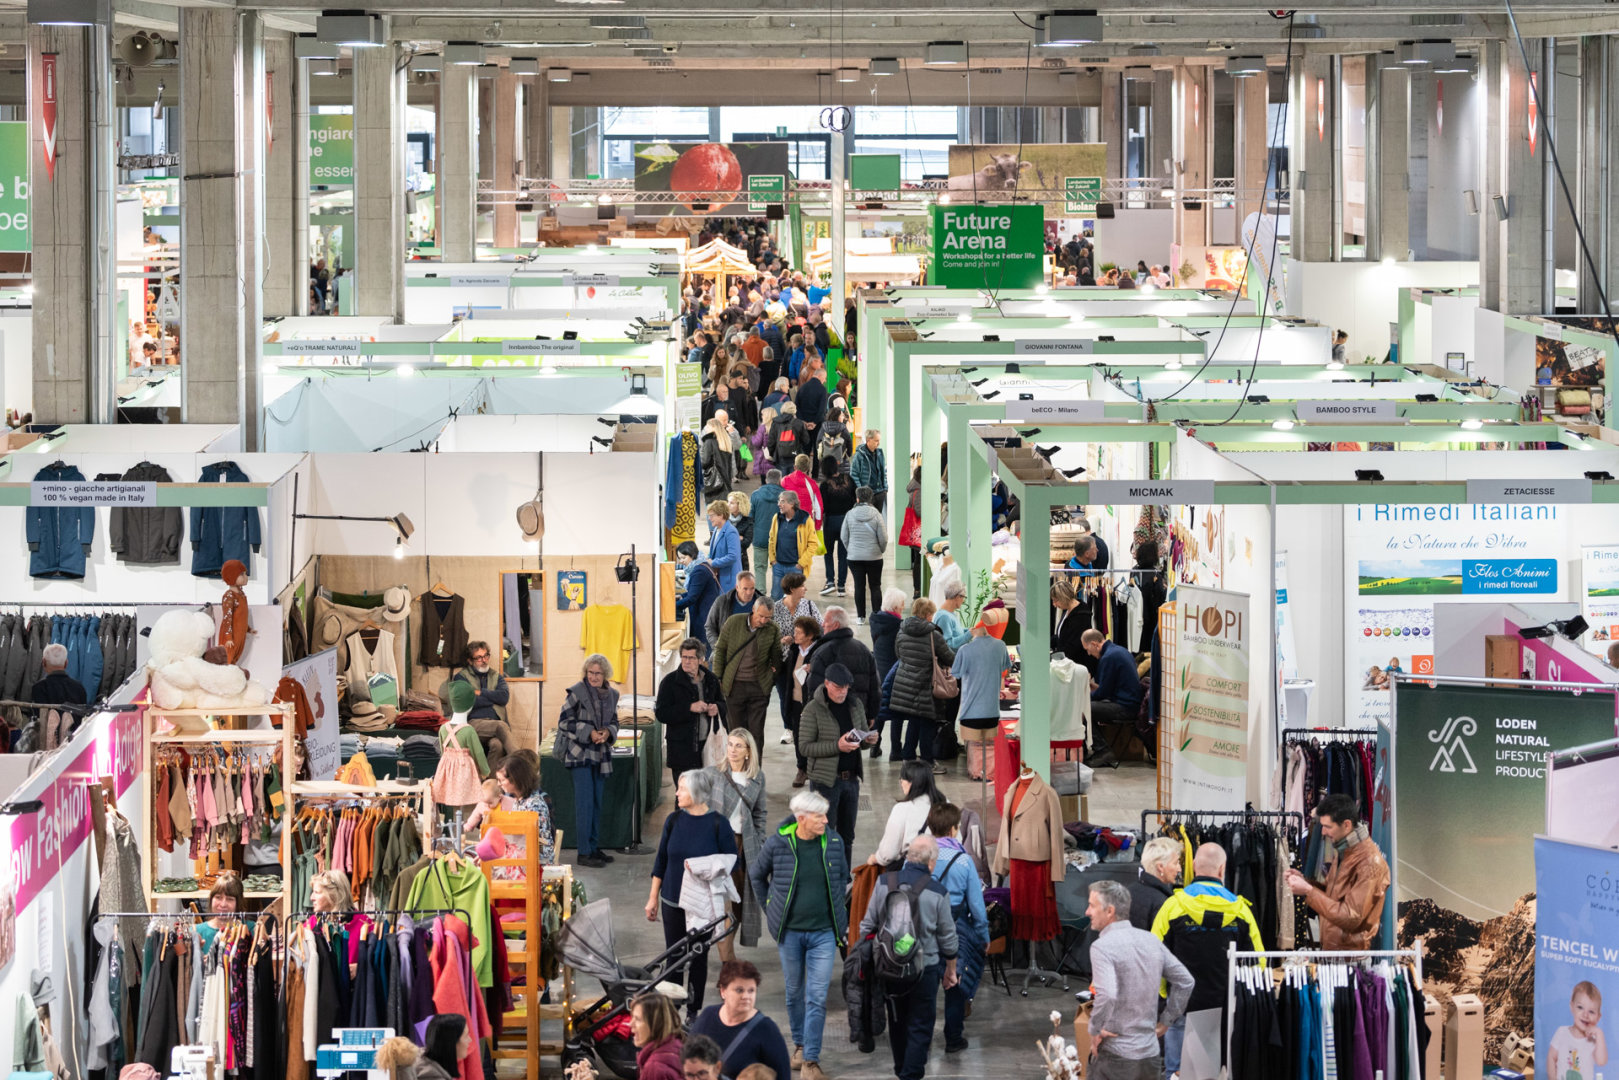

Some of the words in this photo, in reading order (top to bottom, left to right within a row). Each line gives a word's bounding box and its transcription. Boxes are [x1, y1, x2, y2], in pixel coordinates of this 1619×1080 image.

[944, 212, 1011, 230] Future
[943, 232, 1006, 249] Arena
[1130, 488, 1173, 496] MICMAK
[1375, 504, 1460, 520] Rimedi
[1473, 504, 1556, 520] Italiani
[1387, 536, 1399, 549] la
[1402, 533, 1457, 549] Natura
[1460, 536, 1479, 549] che
[1485, 533, 1527, 549] Vibra
[1469, 563, 1499, 578] Flos
[1502, 563, 1551, 578] Animi
[1184, 602, 1241, 641] HOPI
[1184, 634, 1207, 644] BAMBOO
[1208, 638, 1241, 649] UNDERWEAR
[1206, 678, 1242, 692] COMFORT
[1496, 718, 1536, 730] LODEN
[1213, 740, 1240, 754] AMORE
[1496, 734, 1550, 746] NATURAL
[38, 778, 87, 868] Fashion
[115, 718, 142, 777] Adige
[1541, 935, 1598, 958] TENCEL
[1603, 947, 1618, 962] W
[1541, 950, 1563, 960] SUPER
[1565, 955, 1582, 965] SOFT
[1584, 960, 1619, 973] EUCALYPT
